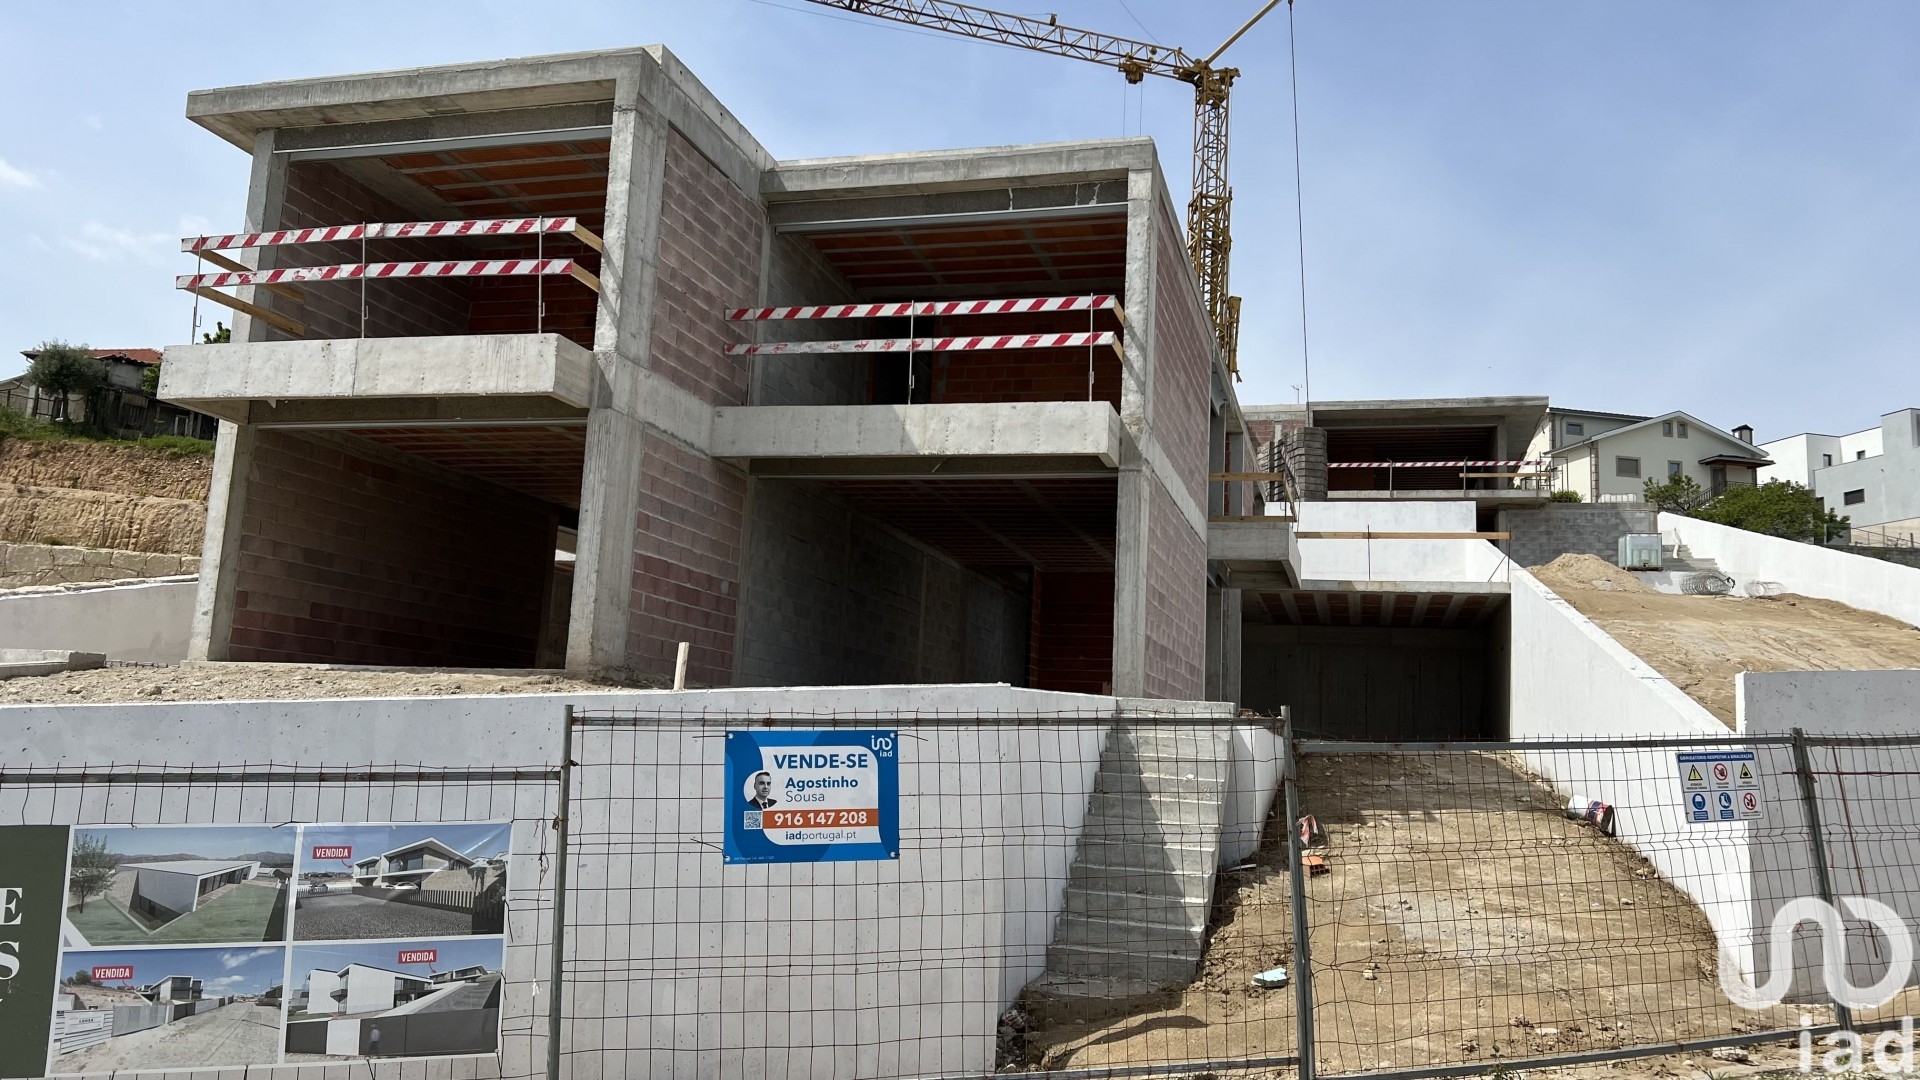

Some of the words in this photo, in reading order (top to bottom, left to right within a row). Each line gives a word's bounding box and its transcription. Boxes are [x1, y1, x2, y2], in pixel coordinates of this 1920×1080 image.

[879, 750, 893, 758] iad
[773, 753, 869, 770] VENDE-SE
[785, 775, 859, 792] Agostinho
[785, 790, 825, 803] Sousa
[774, 812, 804, 826] 916
[807, 811, 836, 825] 147
[839, 811, 868, 825] 208
[785, 830, 857, 842] iadportugal.pt
[316, 848, 349, 858] VENDIDA
[401, 951, 434, 962] VENDIDA
[95, 968, 130, 979] VENDIDA
